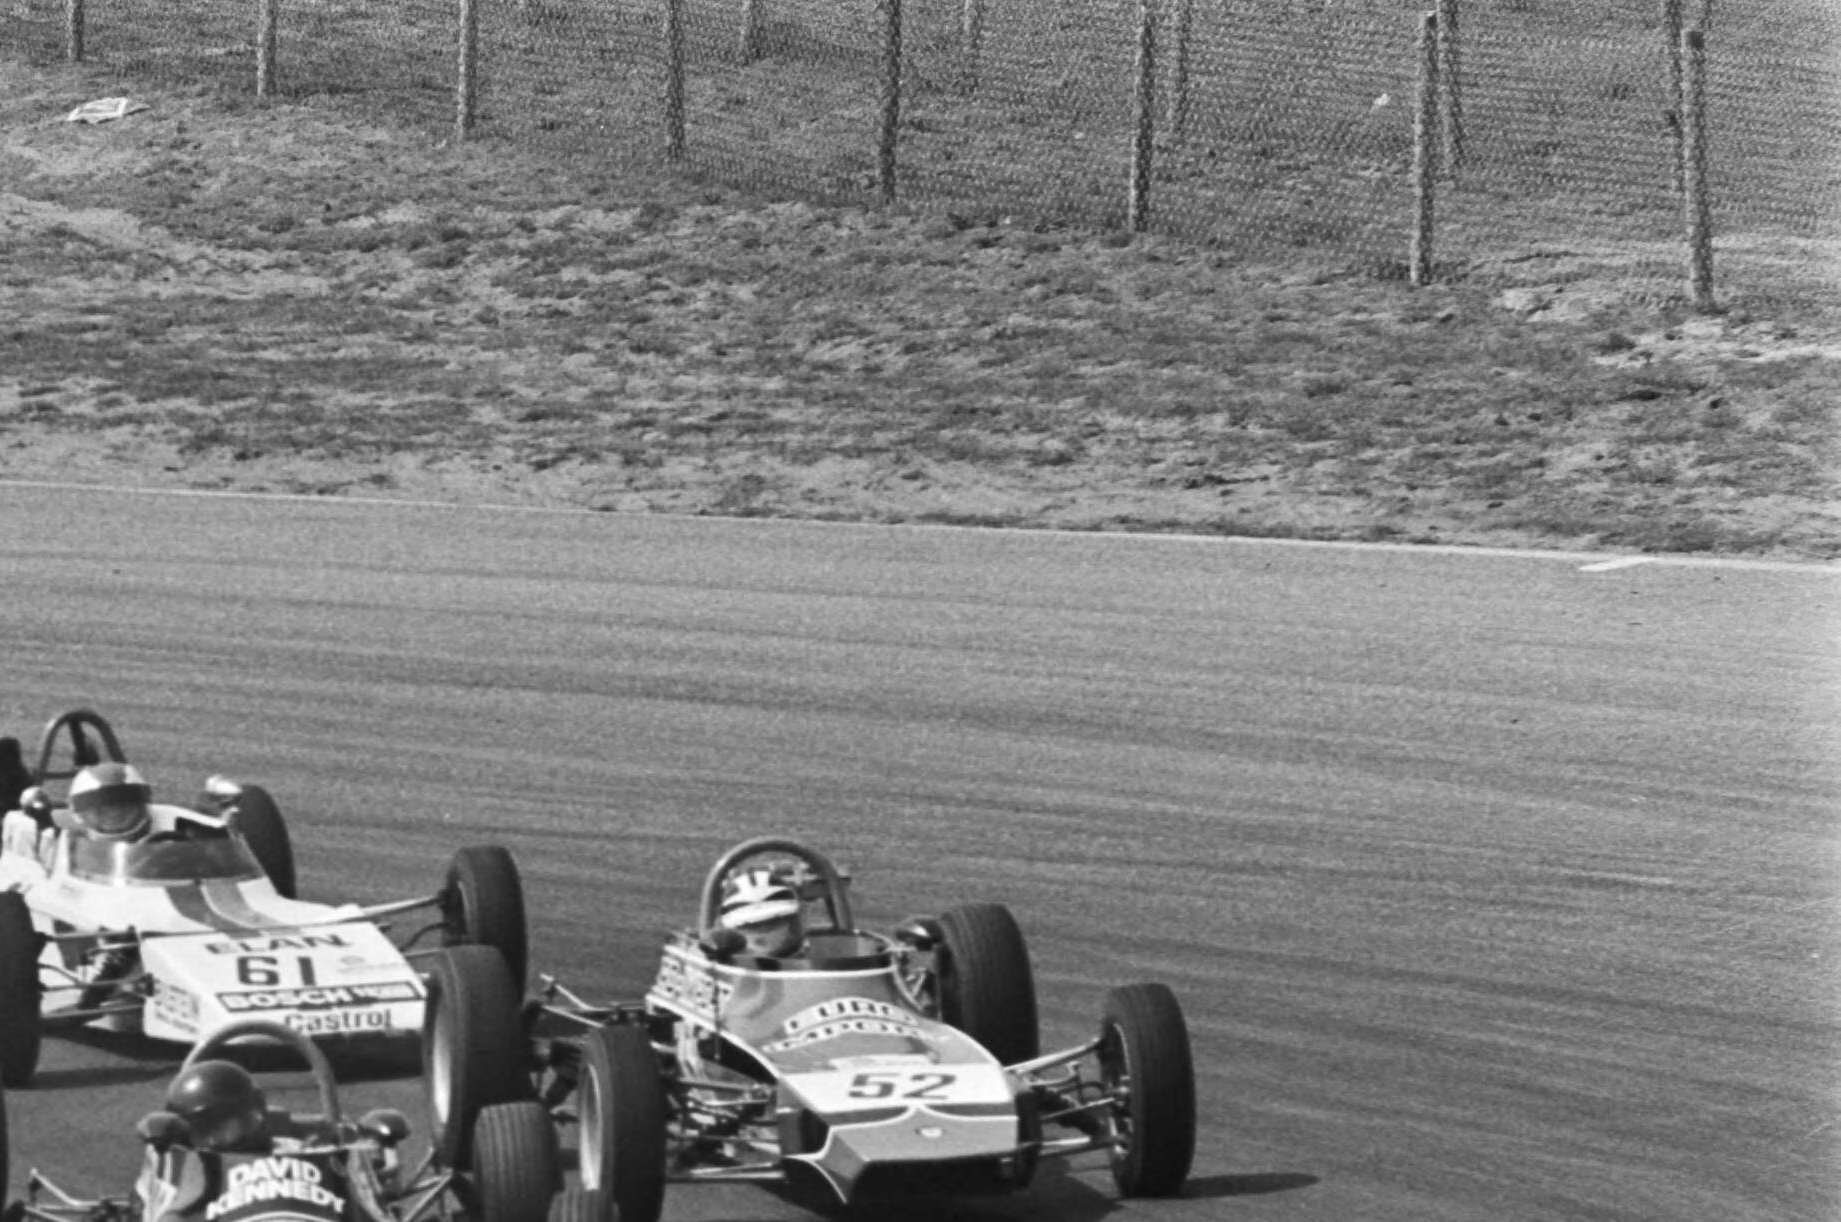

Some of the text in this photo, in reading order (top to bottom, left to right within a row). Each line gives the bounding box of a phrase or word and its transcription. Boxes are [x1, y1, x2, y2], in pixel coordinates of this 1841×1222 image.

[236, 956, 316, 987] 61
[222, 988, 355, 1010] BOSCH
[285, 1009, 392, 1032] Castrol
[848, 1073, 956, 1100] 52
[228, 1157, 322, 1187] DAVID
[205, 1178, 346, 1221] KENNEDY
